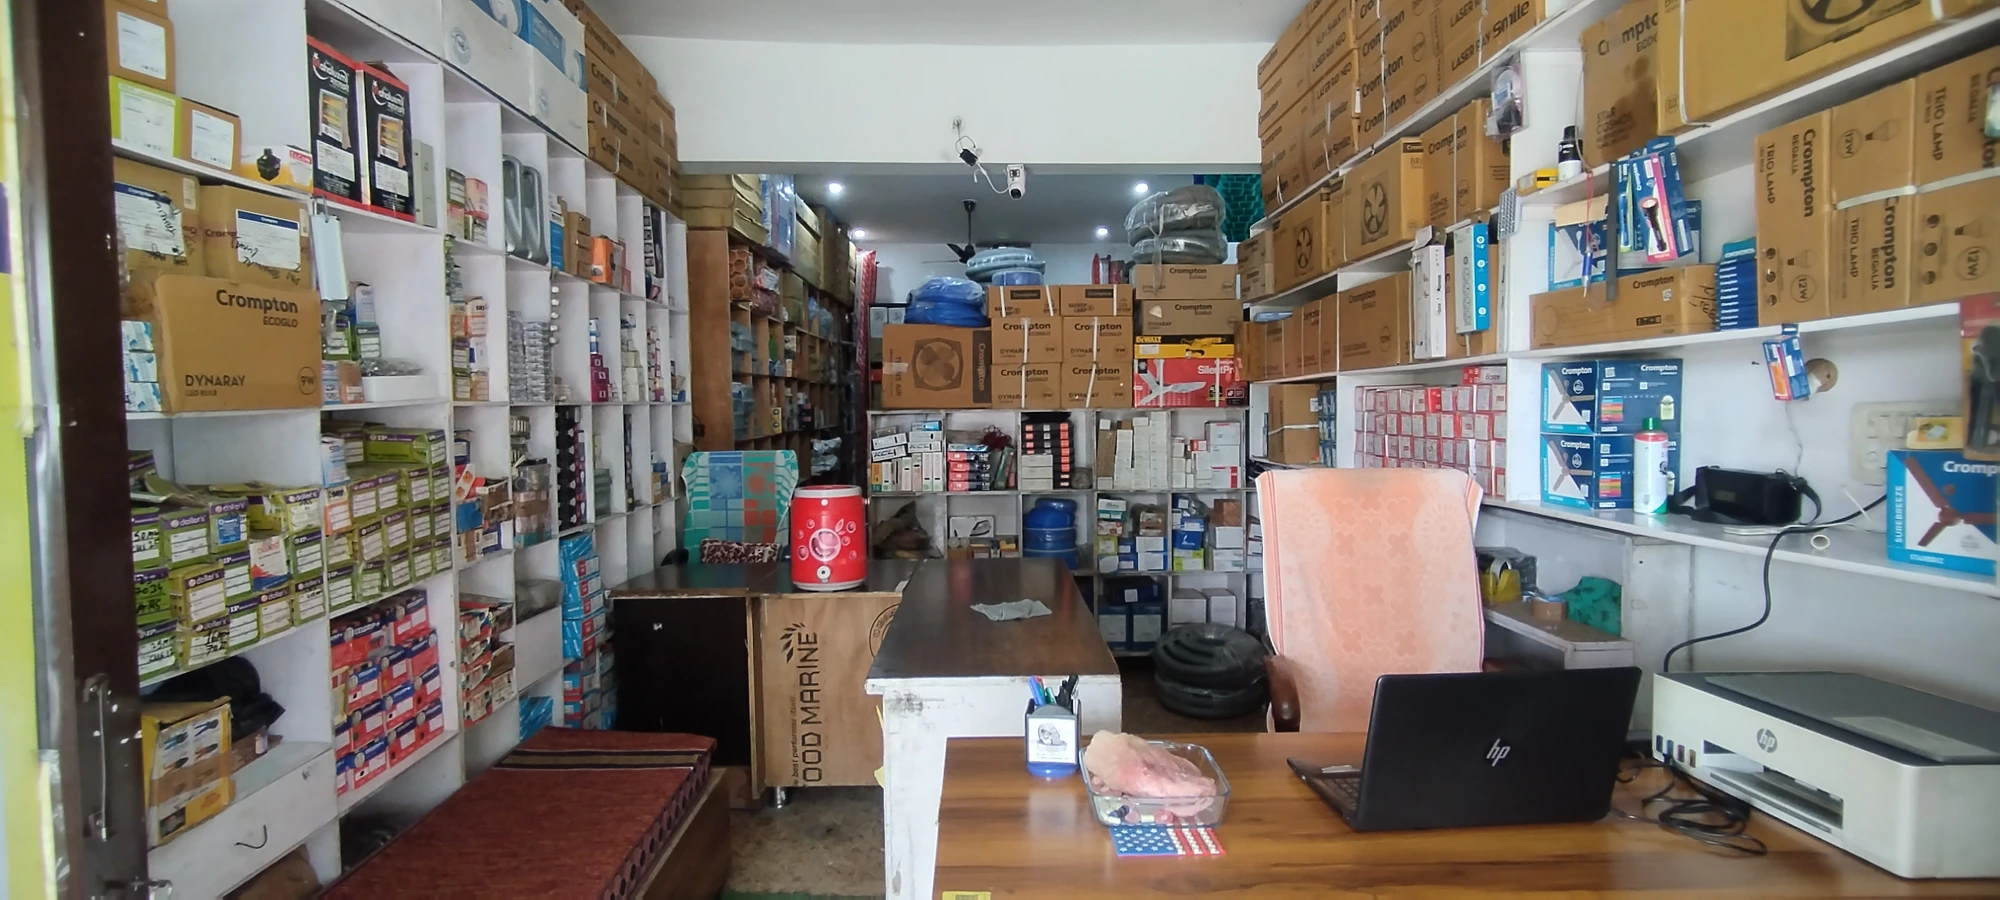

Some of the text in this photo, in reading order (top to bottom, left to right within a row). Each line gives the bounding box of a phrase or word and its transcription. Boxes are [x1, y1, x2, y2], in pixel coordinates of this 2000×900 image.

[1492, 1, 1530, 39] Smile
[1932, 86, 1946, 161] TRIO LAMP
[1791, 133, 1800, 175] REGALIA
[1844, 131, 1854, 155] 12W
[1766, 142, 1776, 205] TRIO LAMP
[1801, 128, 1816, 218] Crompton
[1849, 217, 1860, 279] TRIO LAMP
[1880, 195, 1900, 290] Crompton
[1870, 247, 1880, 291] REGALIA
[1967, 249, 1981, 277] 12W
[1633, 276, 1674, 290] Crompton
[1798, 277, 1808, 301] 12W
[216, 289, 298, 314] Crompton
[263, 315, 298, 328] ECOGLO
[185, 374, 246, 387] DYNARAY
[300, 375, 315, 386] 9W
[1562, 366, 1593, 376] Crompton
[1640, 364, 1678, 374] Crompton
[1560, 440, 1591, 450] Crompton
[796, 632, 823, 725] MARINE
[1486, 738, 1511, 767] hp
[1757, 728, 1778, 753] hp
